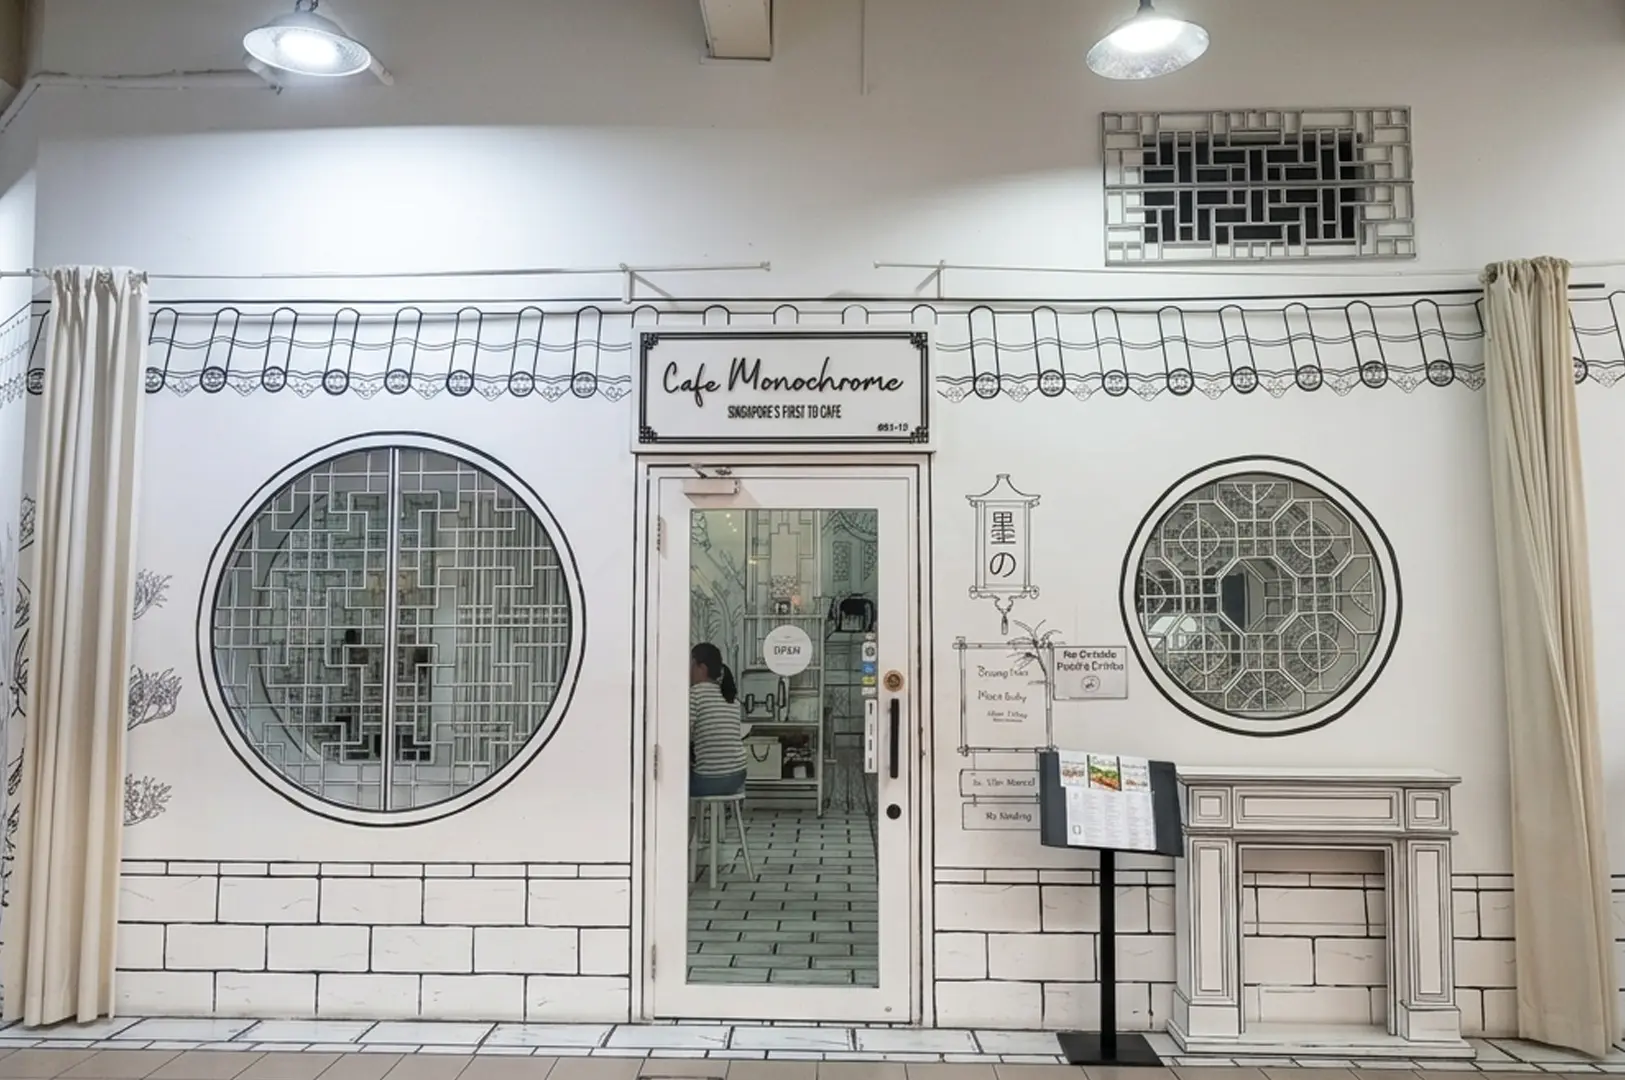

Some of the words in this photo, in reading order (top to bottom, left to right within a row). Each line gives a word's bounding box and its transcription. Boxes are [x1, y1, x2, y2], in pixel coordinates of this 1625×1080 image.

[662, 360, 722, 408] Cafe
[727, 356, 905, 393] Monochrome
[782, 404, 805, 419] FIRST
[820, 404, 842, 419] CAFE
